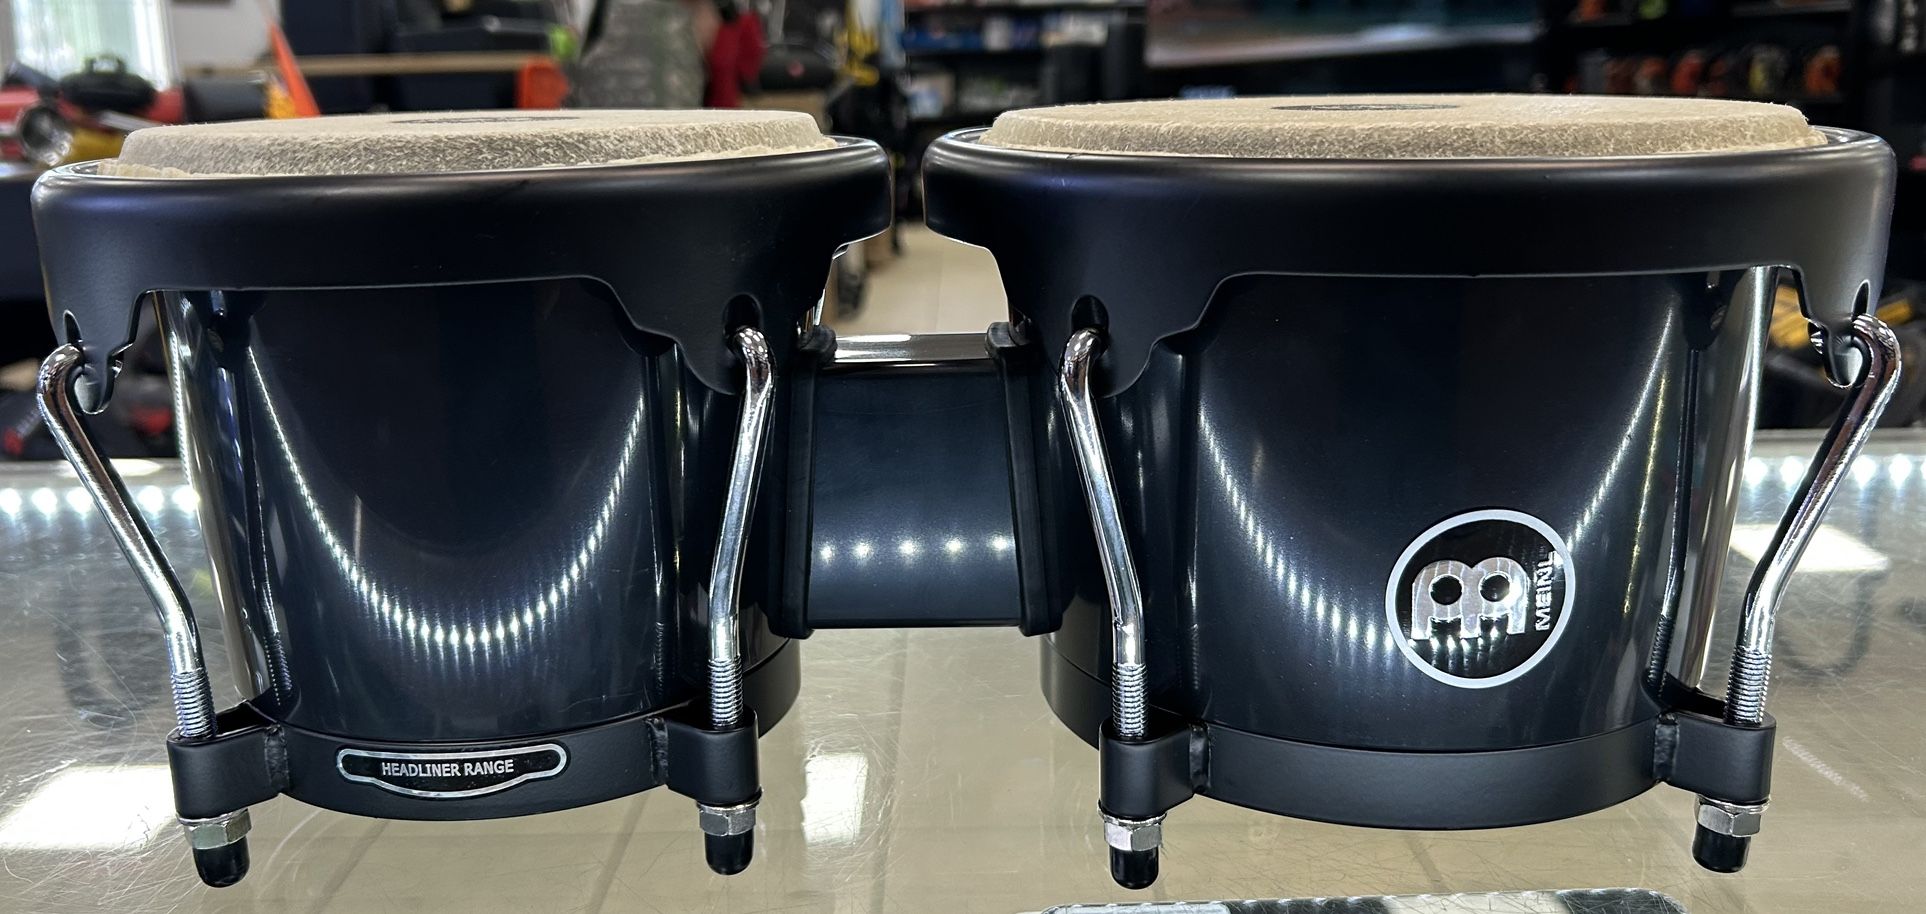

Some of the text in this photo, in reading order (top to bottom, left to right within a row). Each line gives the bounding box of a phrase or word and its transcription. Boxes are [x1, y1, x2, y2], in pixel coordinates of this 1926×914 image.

[1535, 551, 1553, 631] MEINL
[381, 759, 514, 777] HEADLINER RANGE
